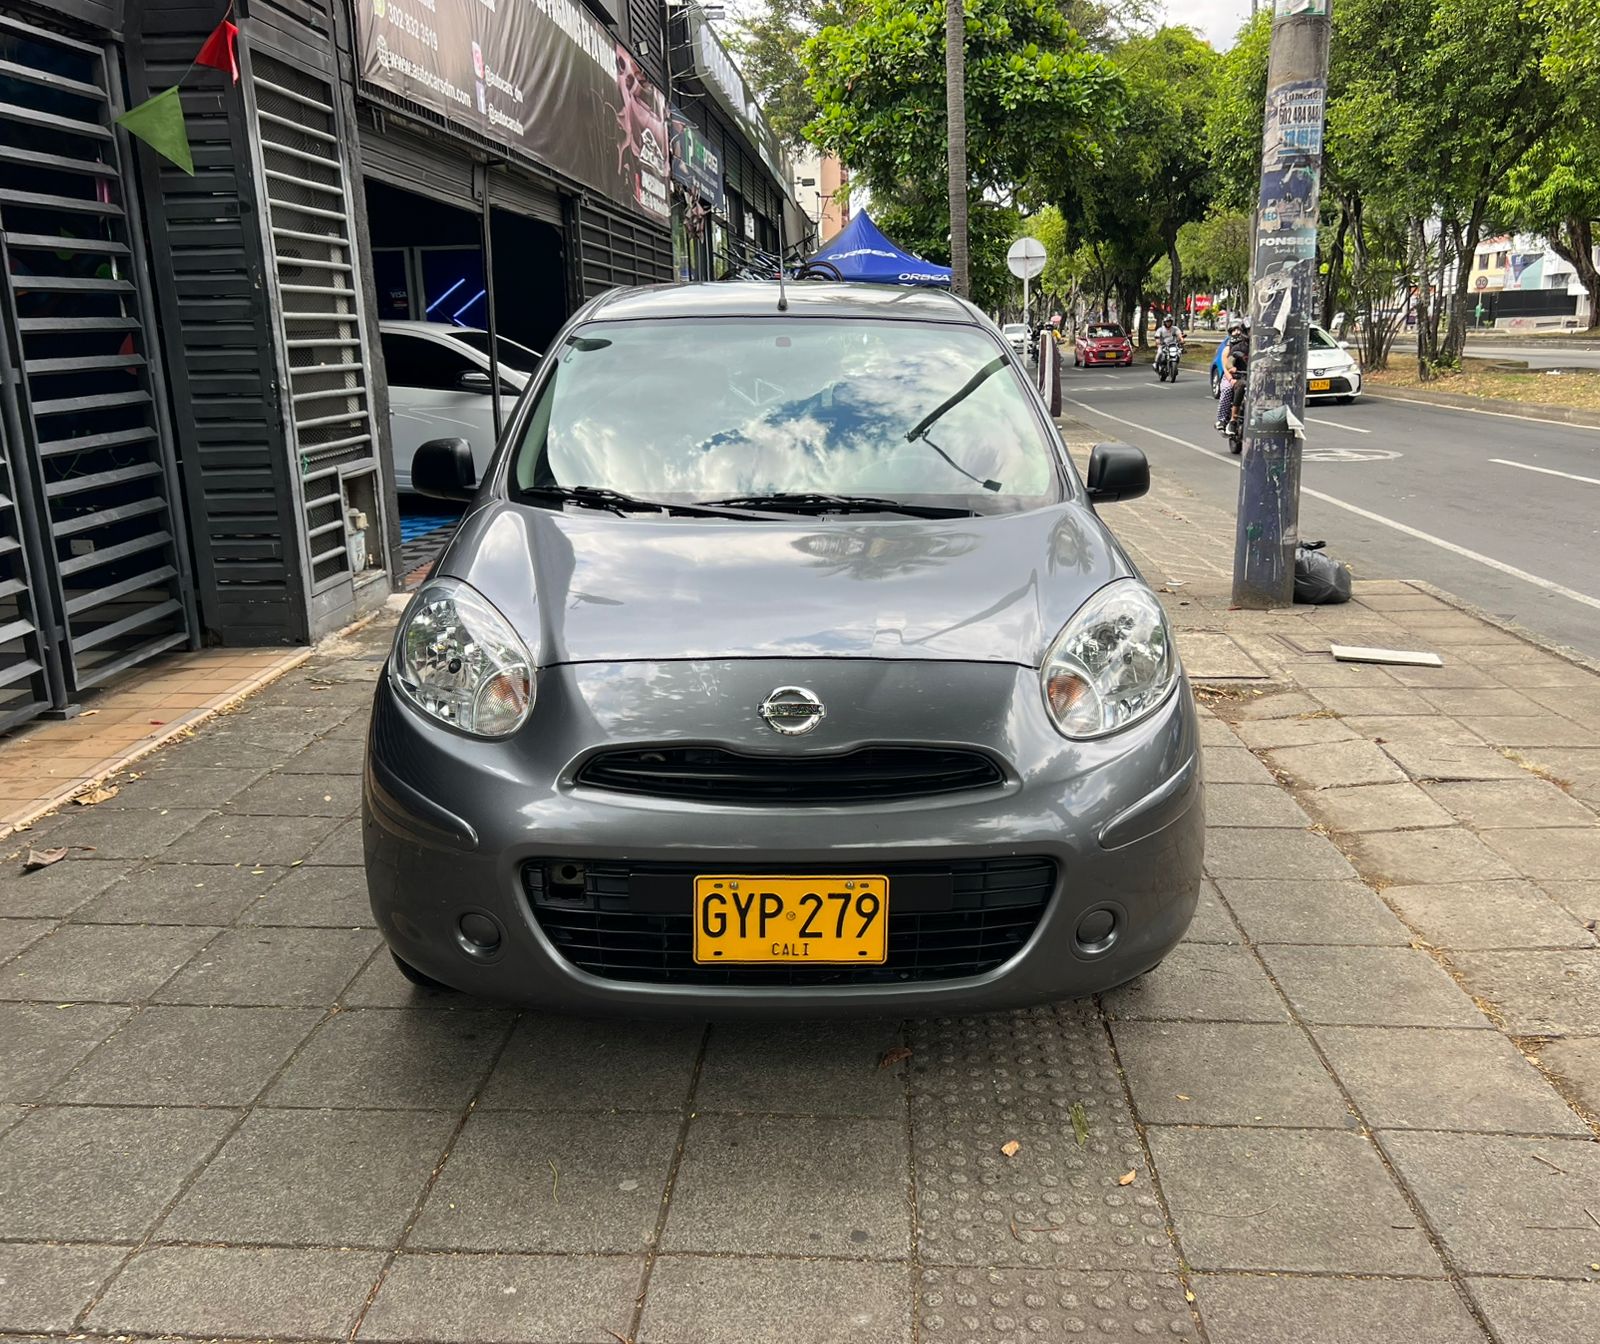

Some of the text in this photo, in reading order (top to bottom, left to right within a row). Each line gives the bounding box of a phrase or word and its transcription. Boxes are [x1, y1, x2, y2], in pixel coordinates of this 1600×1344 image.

[828, 248, 898, 260] ORBEA
[898, 272, 951, 282] ORBEA
[702, 892, 880, 939] GYP 279
[771, 942, 809, 956] CALI
